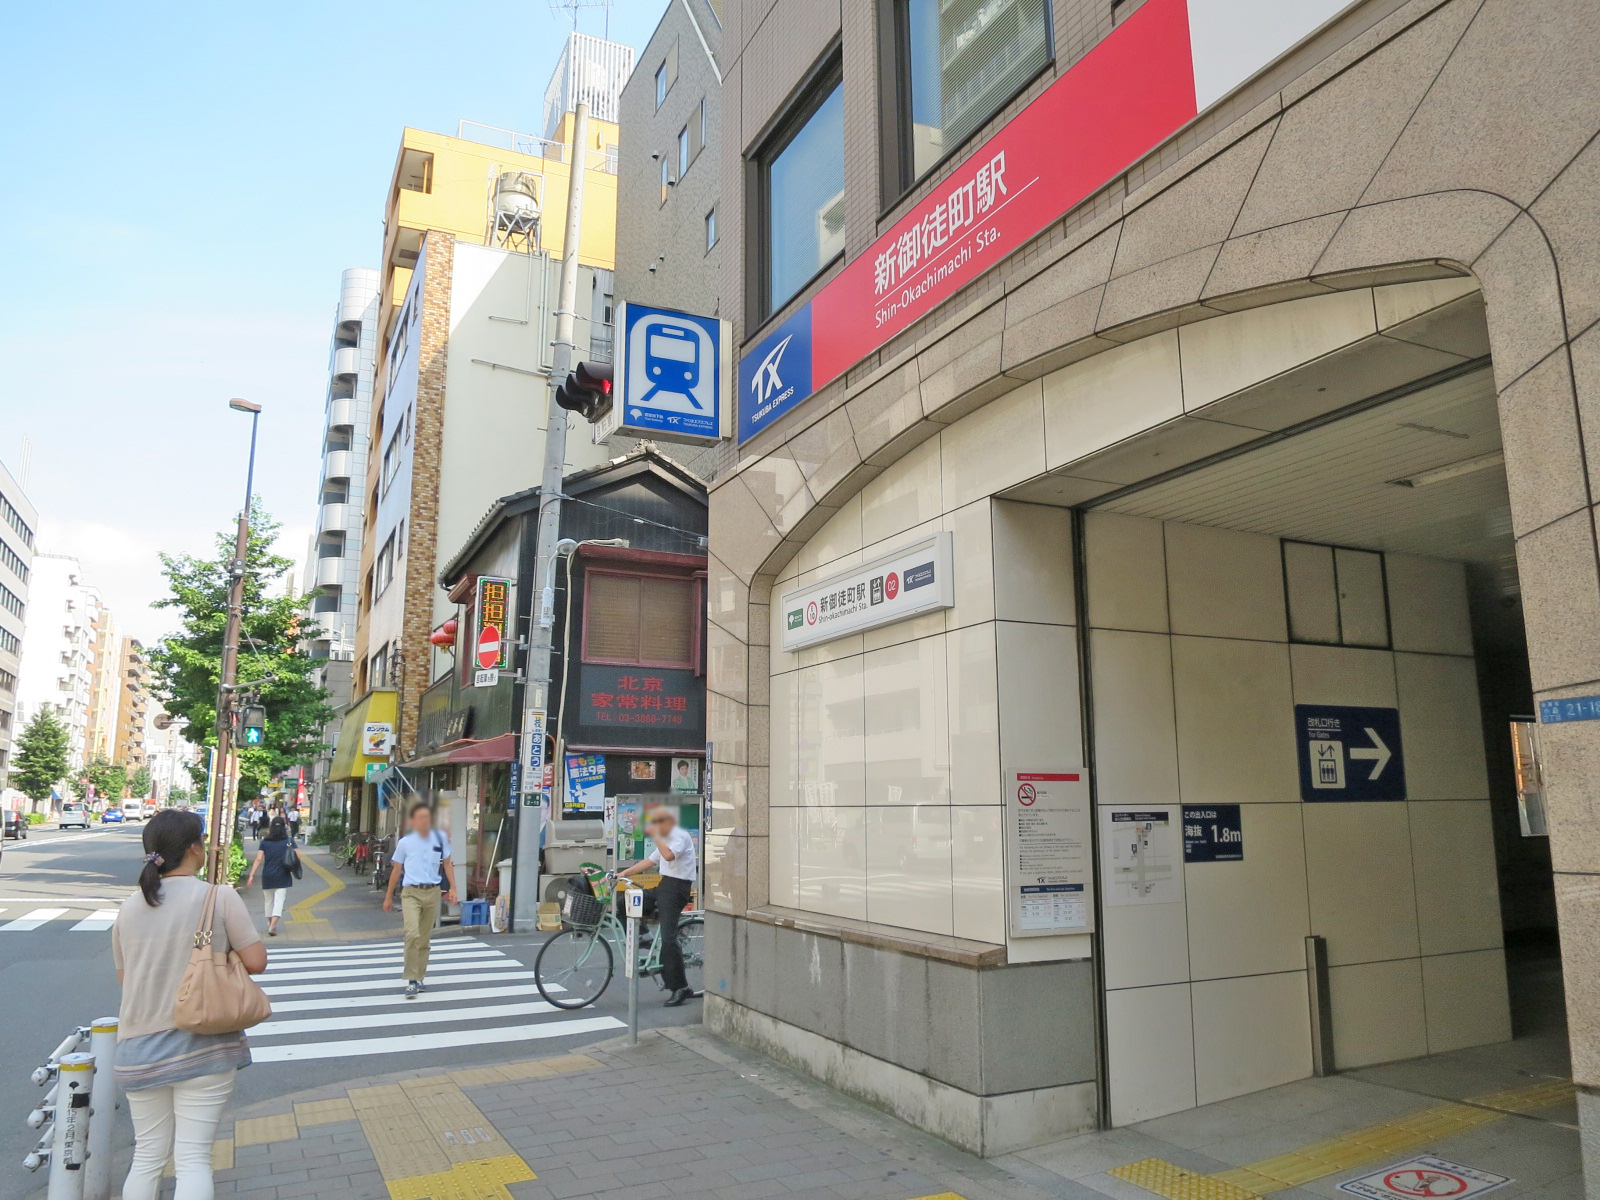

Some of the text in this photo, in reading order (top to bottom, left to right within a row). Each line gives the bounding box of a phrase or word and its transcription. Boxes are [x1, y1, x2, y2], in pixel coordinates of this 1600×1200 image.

[874, 150, 1008, 295] 新御徒町駅
[875, 227, 1001, 328] Shin-Okachimachi Sta.
[751, 386, 794, 424] TSUKUBA EXPRESS
[887, 579, 897, 592] 02
[820, 583, 866, 614] 新御徒町駅
[617, 675, 664, 691] 北京
[591, 692, 688, 711] 家常料理
[1184, 811, 1217, 819] この出入口は
[1184, 825, 1203, 837] 海抜
[1211, 824, 1241, 843] 1.8m
